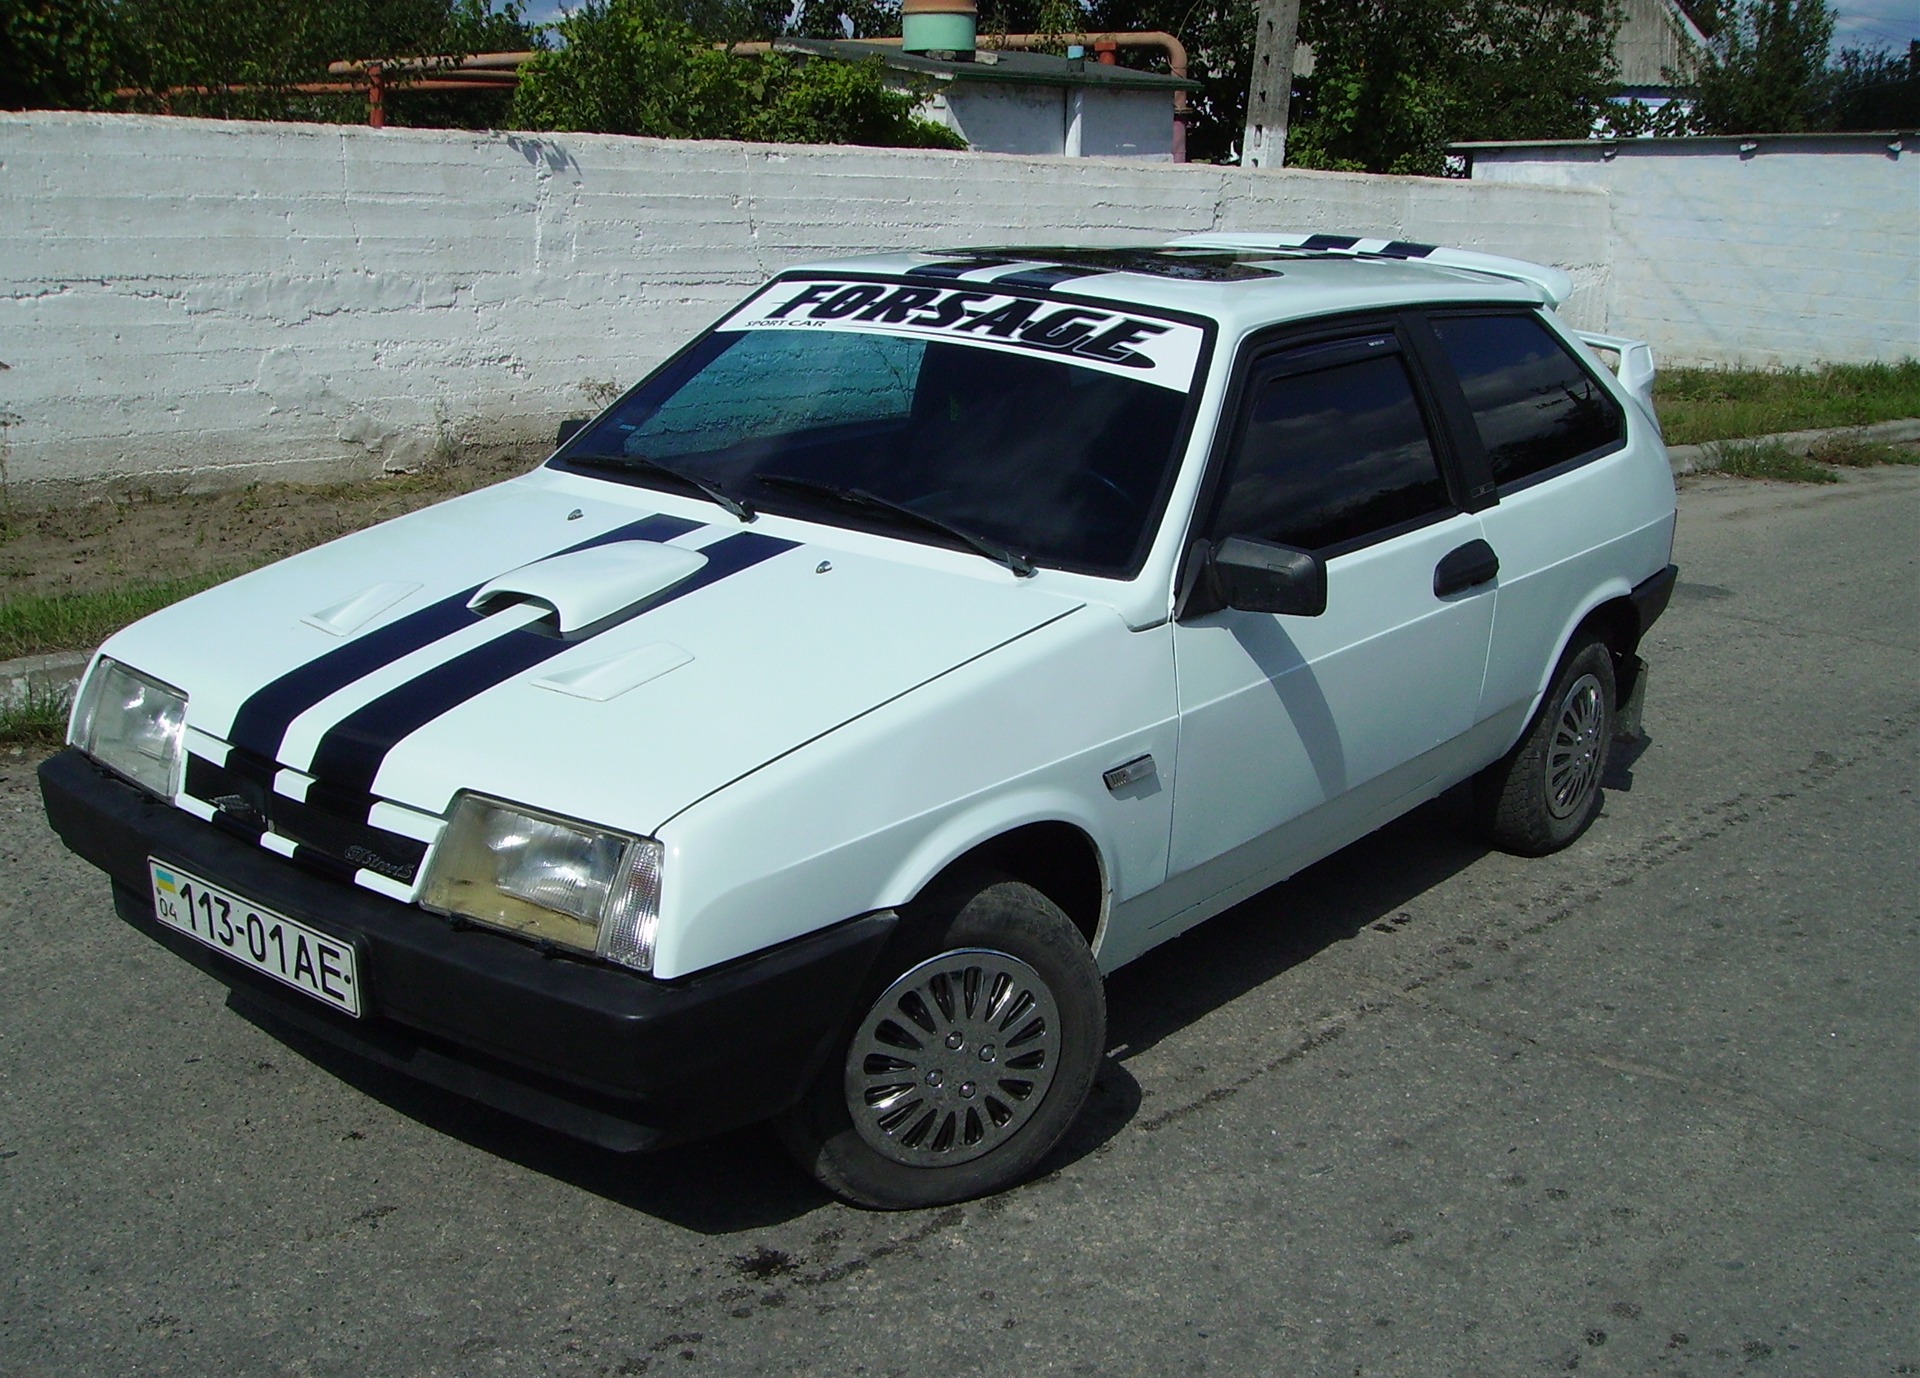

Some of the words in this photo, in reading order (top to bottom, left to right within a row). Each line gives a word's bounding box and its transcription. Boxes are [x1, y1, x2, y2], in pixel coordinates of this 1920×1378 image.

[745, 320, 788, 328] SPORT
[788, 320, 827, 328] CAR
[764, 284, 1174, 362] FORSAGE
[160, 897, 177, 921] 04
